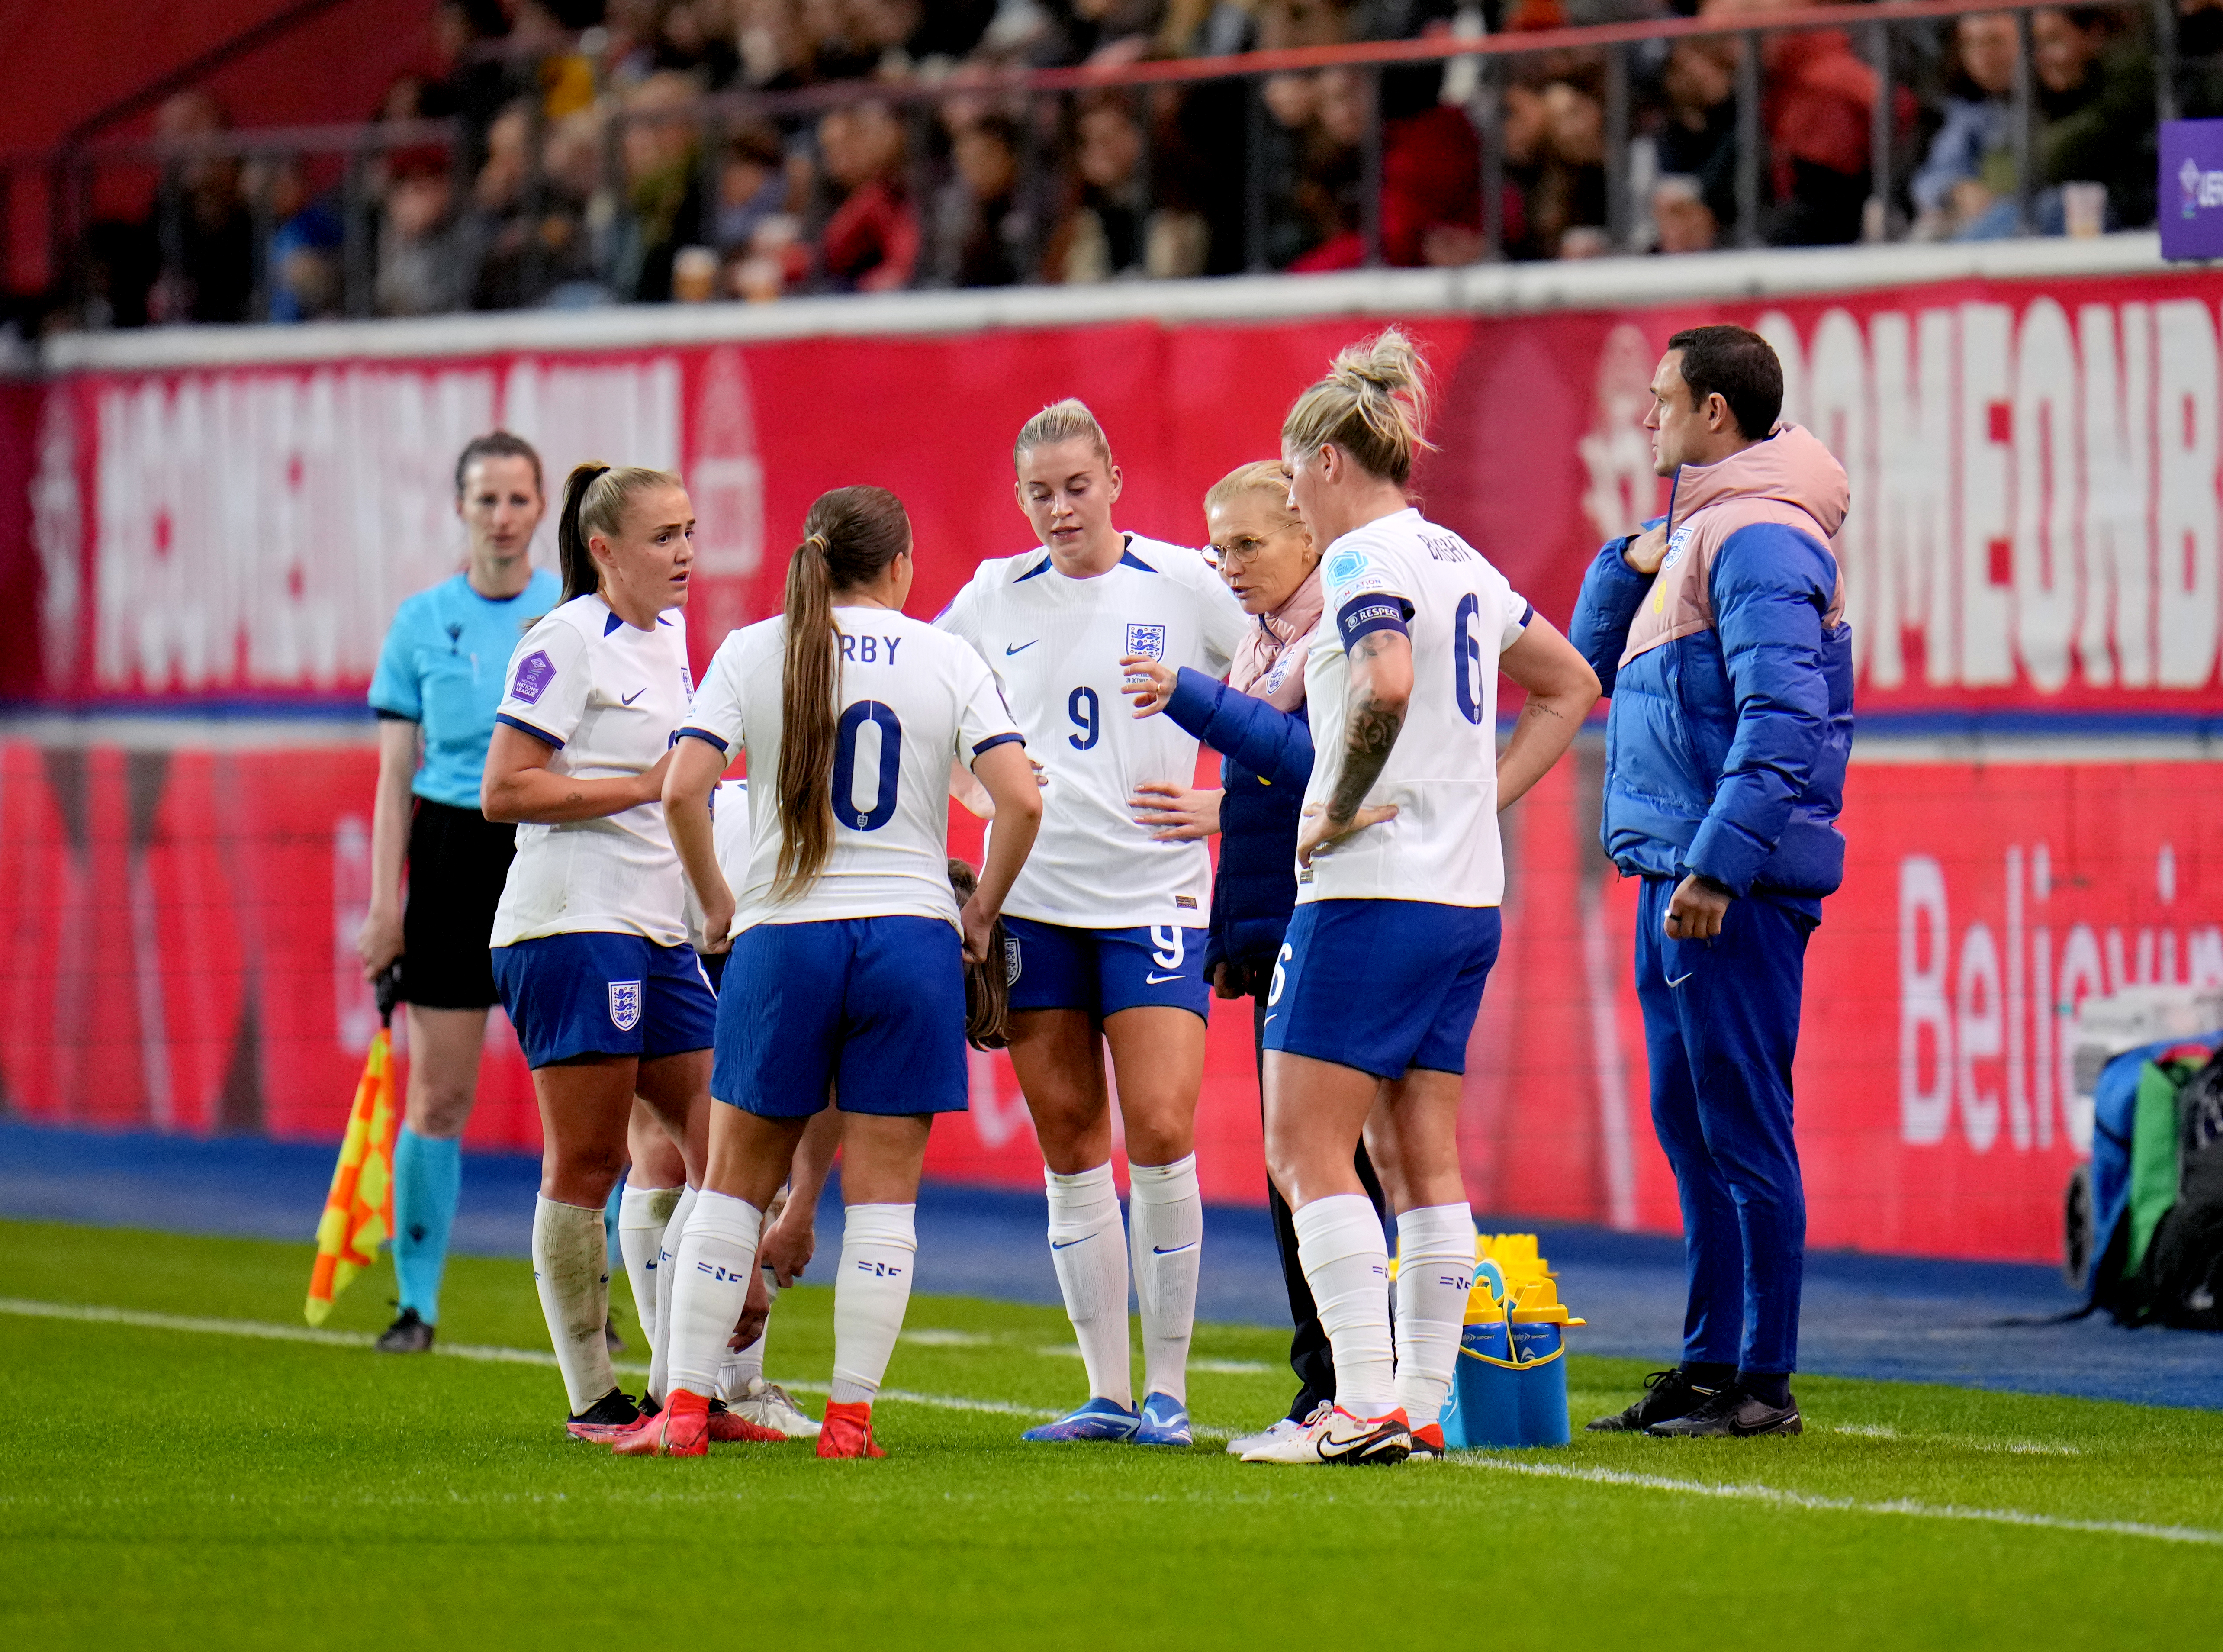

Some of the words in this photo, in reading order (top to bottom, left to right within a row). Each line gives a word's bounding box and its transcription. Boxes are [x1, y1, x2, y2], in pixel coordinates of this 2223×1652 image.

[1359, 608, 1400, 620] RESPECT
[1454, 592, 1484, 725] 6
[515, 686, 536, 697] LEAGUE
[516, 682, 539, 693] NATIONS
[1068, 686, 1099, 750] 9
[1150, 926, 1184, 969] 9
[1267, 942, 1293, 1007] 6
